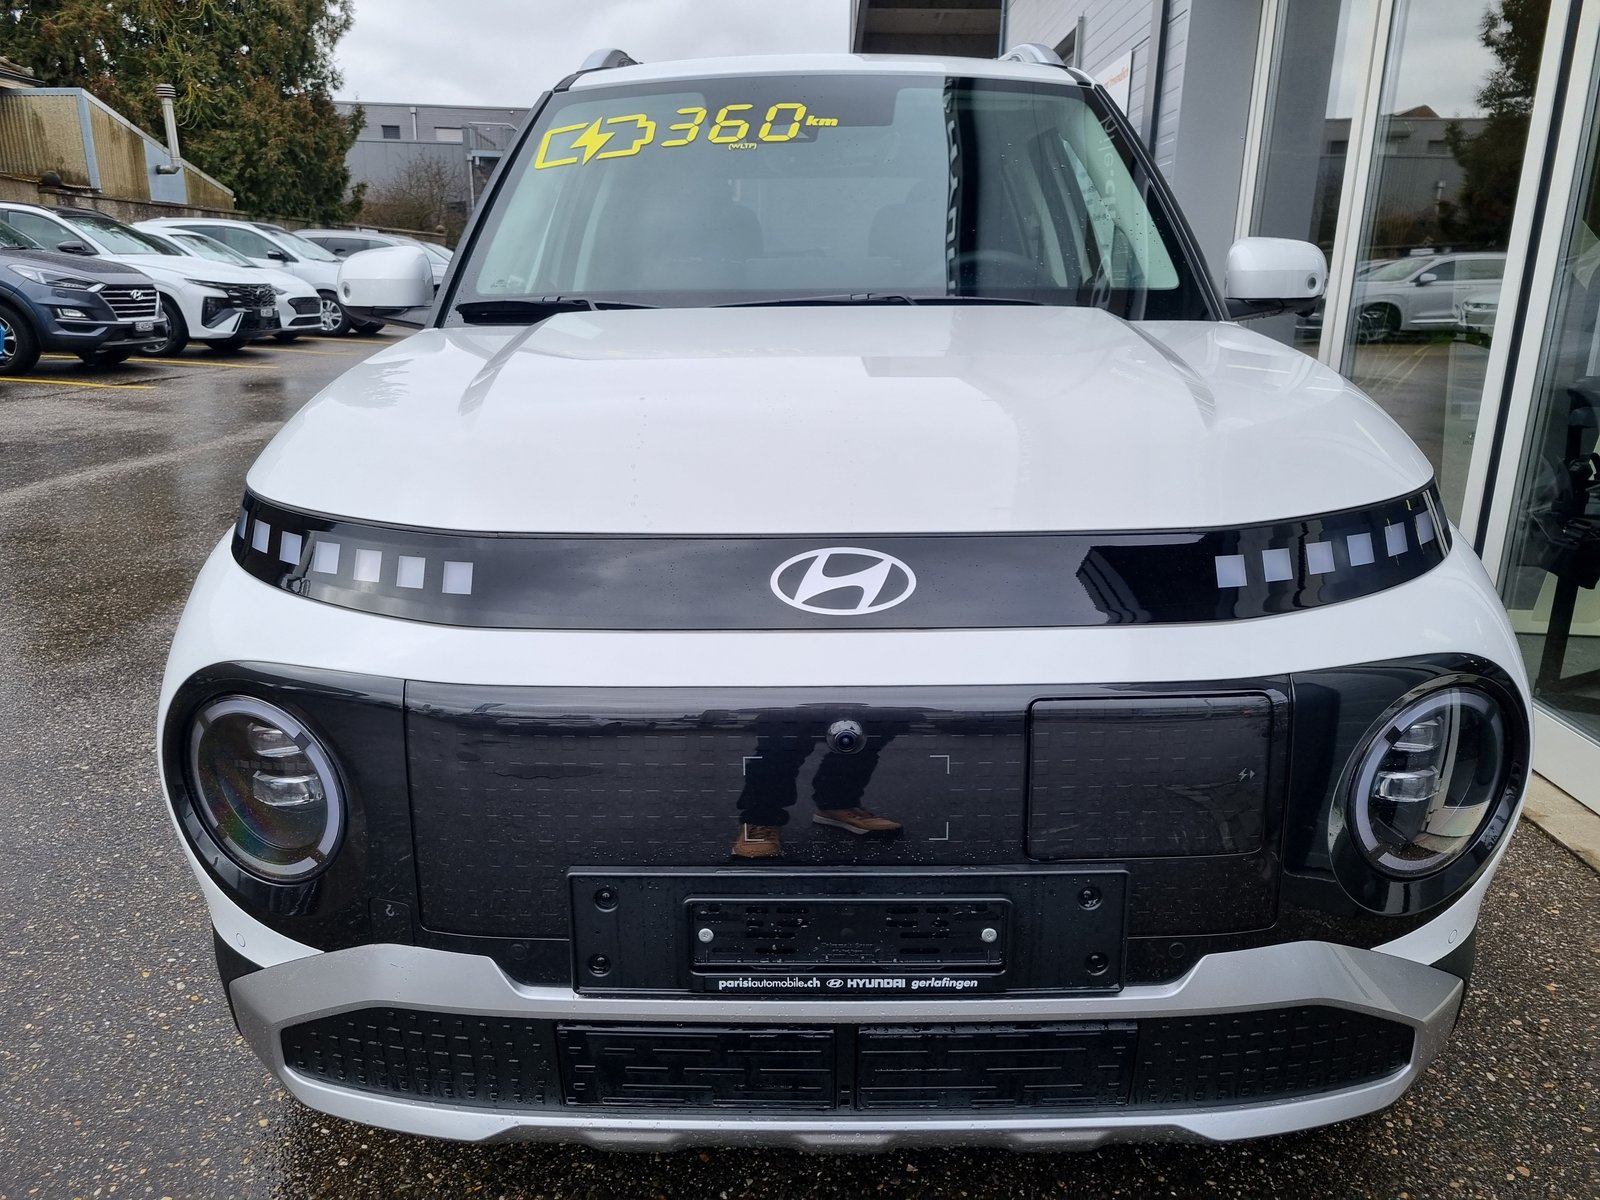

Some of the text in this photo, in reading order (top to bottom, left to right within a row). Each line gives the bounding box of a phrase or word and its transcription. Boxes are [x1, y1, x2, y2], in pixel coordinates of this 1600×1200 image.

[661, 103, 839, 147] 360 km
[728, 142, 757, 151] (WLTP)
[718, 976, 978, 990] parisiautomobile.ch HYUNDAI gerlafingen
